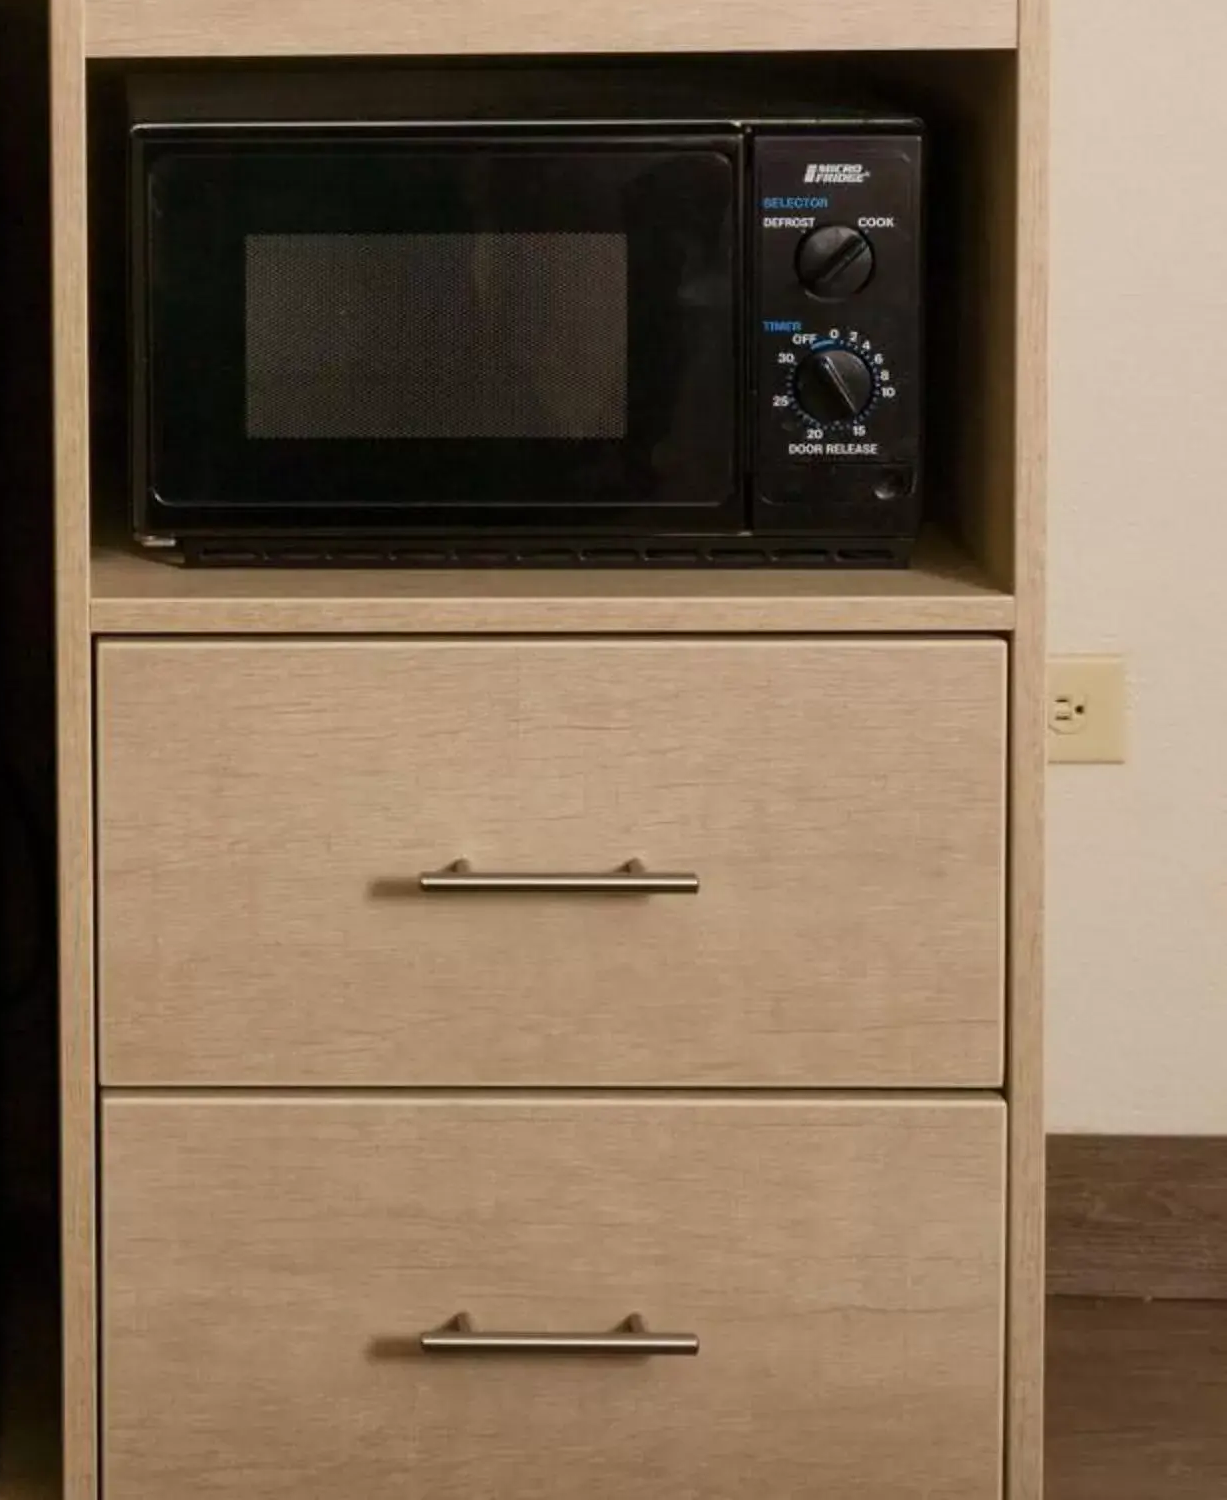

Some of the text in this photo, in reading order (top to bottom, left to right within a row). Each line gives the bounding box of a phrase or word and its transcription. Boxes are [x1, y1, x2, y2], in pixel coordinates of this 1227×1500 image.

[818, 164, 863, 173] MICRO
[815, 173, 864, 183] FRIDGE
[763, 197, 828, 208] SELECTOR
[763, 217, 816, 228] DEFROST
[858, 217, 894, 228] COOK
[763, 321, 802, 332] TIMER
[792, 333, 817, 345] OFF
[830, 329, 840, 339] 0
[849, 331, 858, 342] 2
[862, 340, 871, 351] 4
[778, 353, 795, 364] 30
[874, 354, 884, 365] 6
[880, 370, 890, 380] 8
[882, 387, 896, 398] 10
[773, 395, 790, 407] 25
[807, 429, 823, 439] 20
[853, 425, 866, 436] 15
[788, 443, 878, 455] DOOR RELEASE
